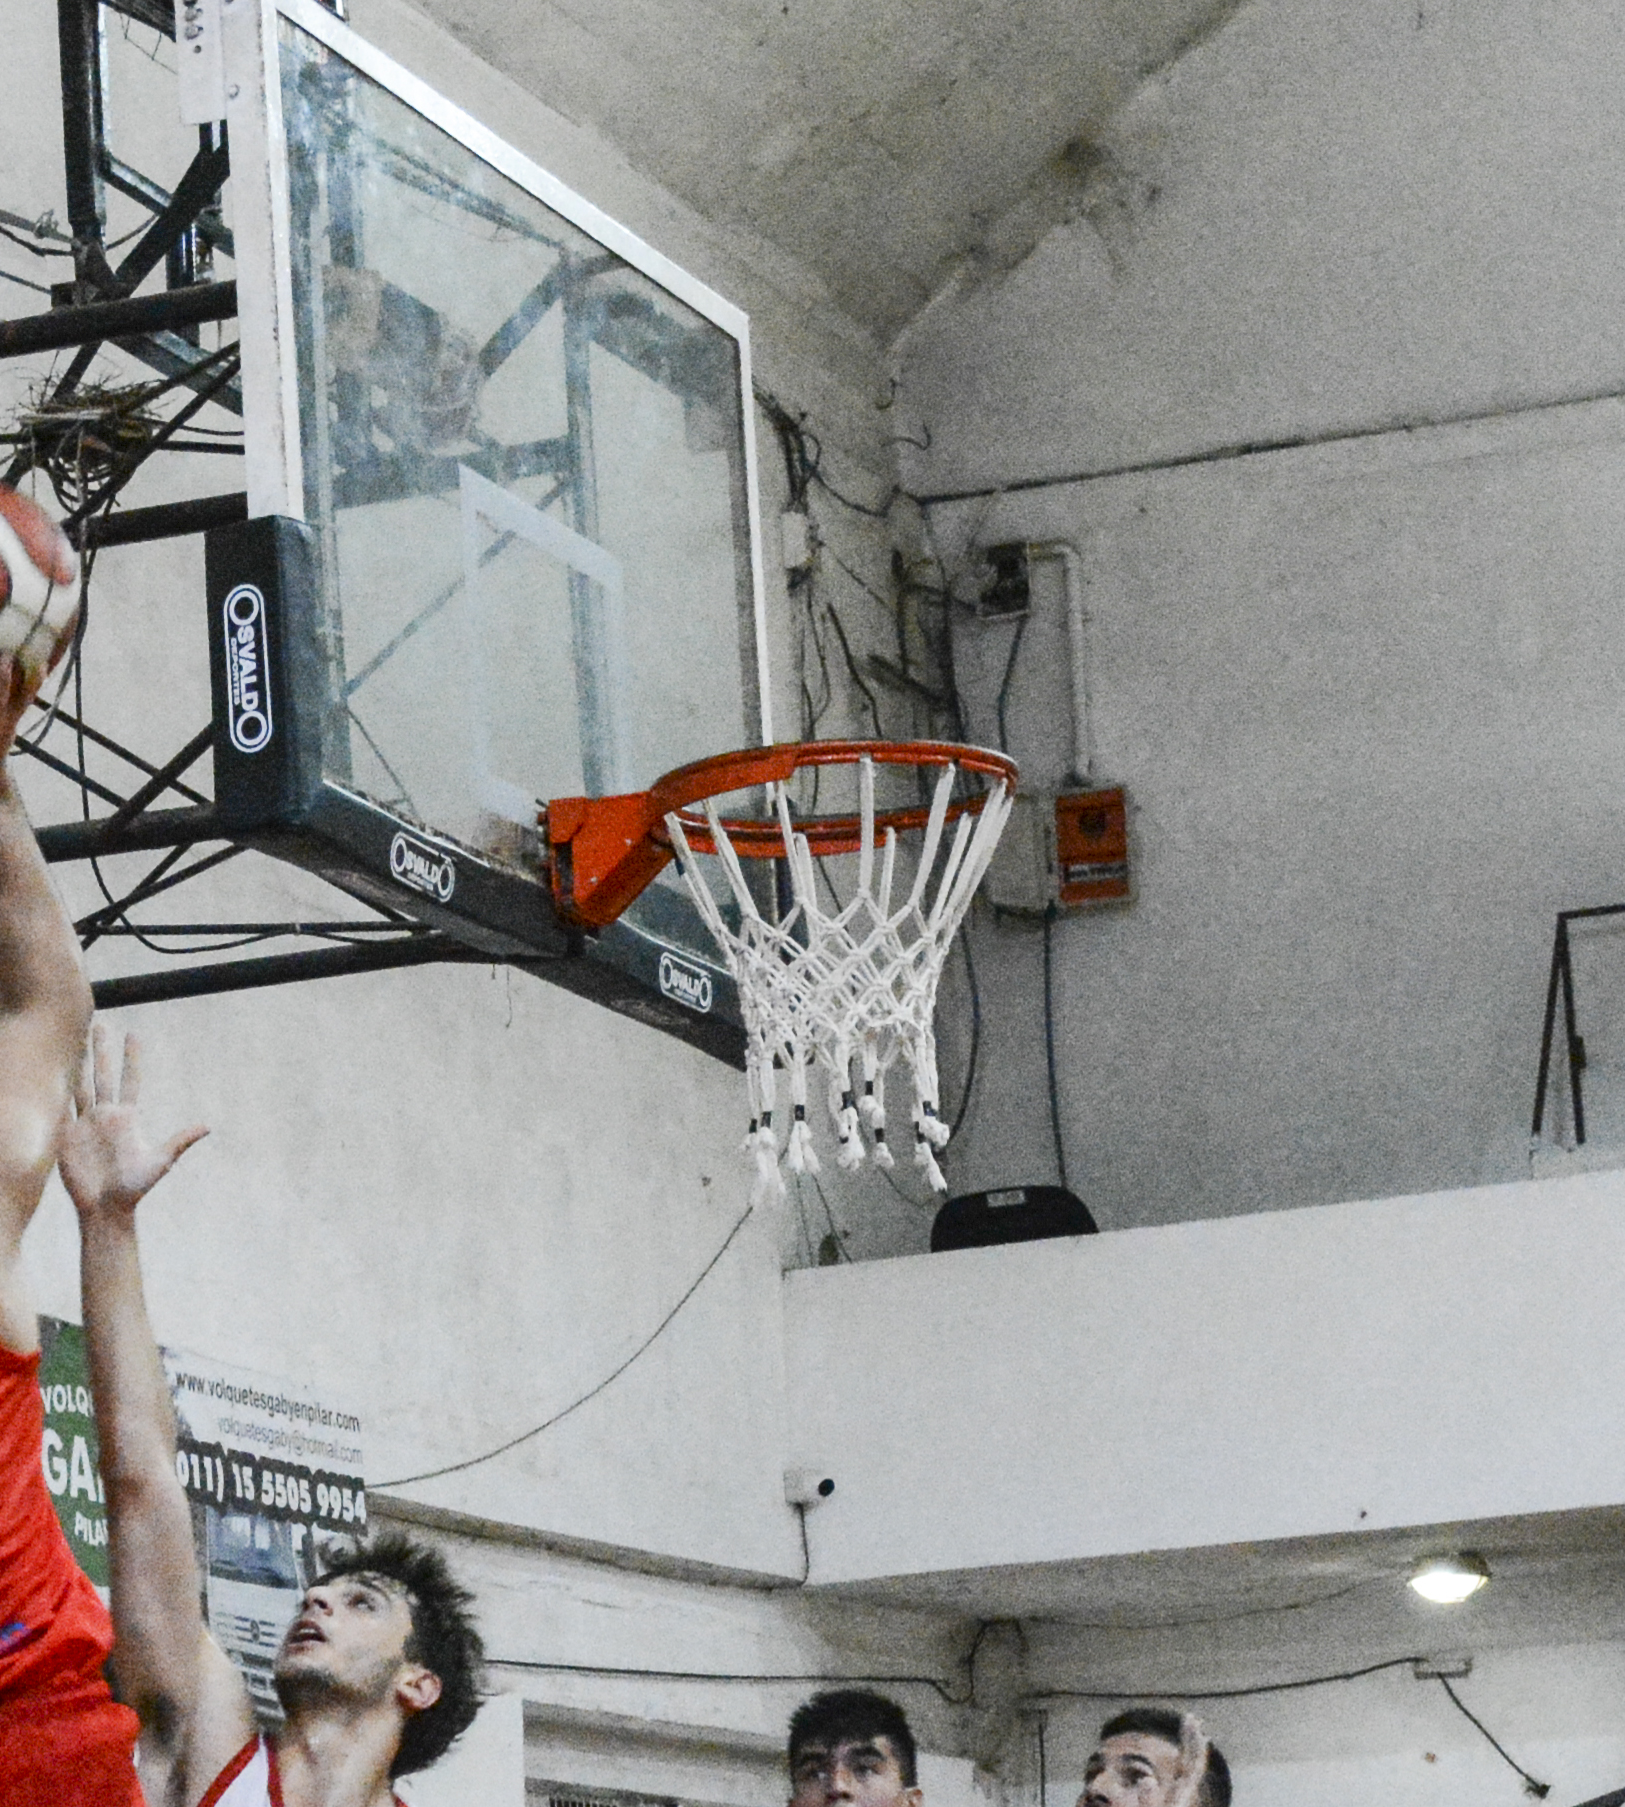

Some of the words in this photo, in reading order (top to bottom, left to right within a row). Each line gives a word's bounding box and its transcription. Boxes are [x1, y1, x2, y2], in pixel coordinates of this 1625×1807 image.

[228, 589, 268, 747] OSVALDO
[393, 837, 452, 897] OSVALDO
[40, 1384, 95, 1417] VOLQ
[175, 1450, 224, 1502] 011)
[232, 1463, 256, 1501] 15
[261, 1470, 312, 1513] 5505
[316, 1483, 368, 1525] 9954
